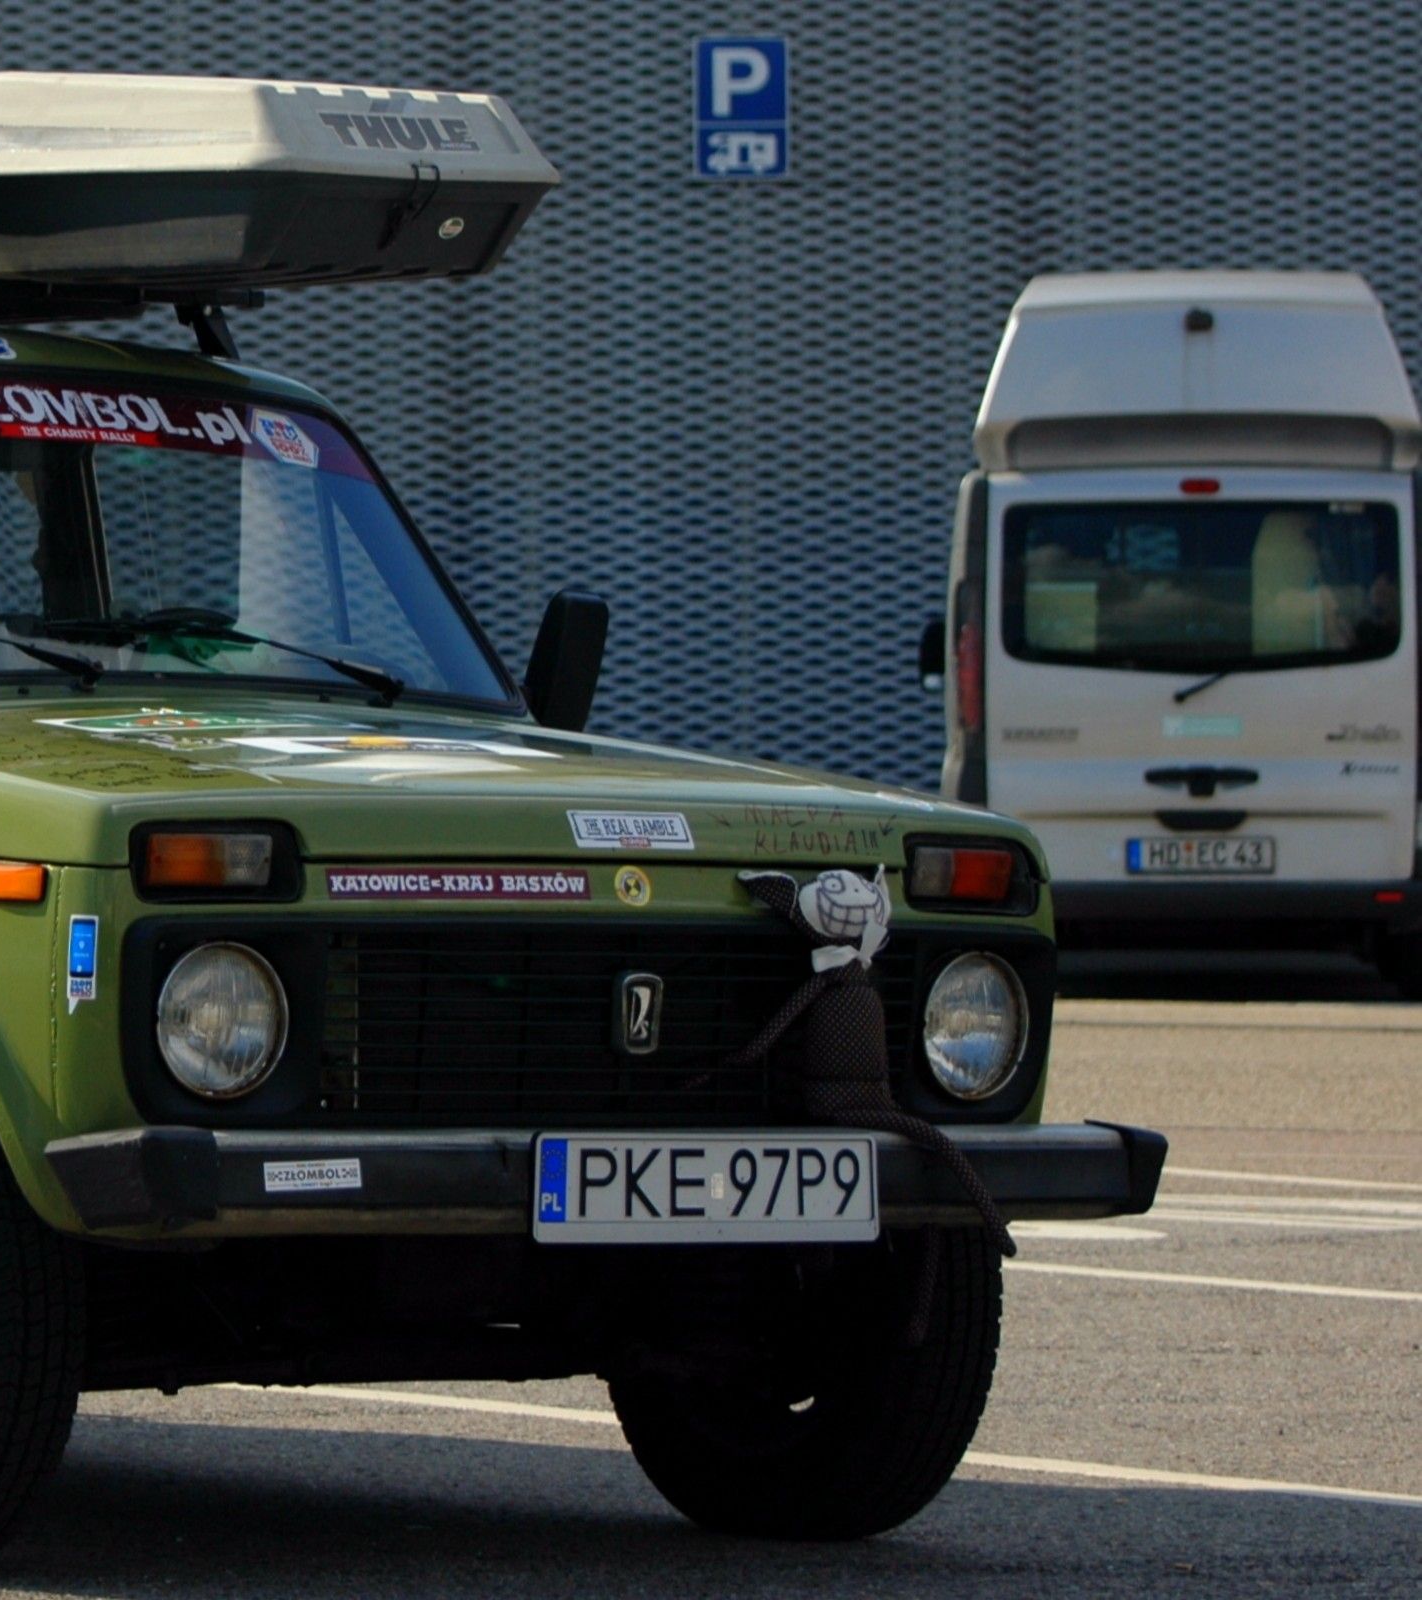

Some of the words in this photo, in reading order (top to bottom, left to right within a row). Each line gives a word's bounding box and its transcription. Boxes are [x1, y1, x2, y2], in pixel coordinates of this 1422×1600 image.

[712, 46, 771, 119] P
[319, 112, 480, 151] THULE
[43, 427, 97, 440] CHARITY
[99, 430, 137, 443] RALLY
[602, 818, 634, 836] REAL
[633, 818, 679, 836] GAMBLE
[1149, 841, 1179, 865] HD
[1197, 841, 1227, 865] EC
[1234, 841, 1263, 865] 43
[499, 872, 585, 893] BASKÓW
[283, 1167, 341, 1182] ZŁOMBOL
[578, 1147, 706, 1218] PKE
[729, 1147, 861, 1218] 97P9
[540, 1192, 563, 1213] PL
